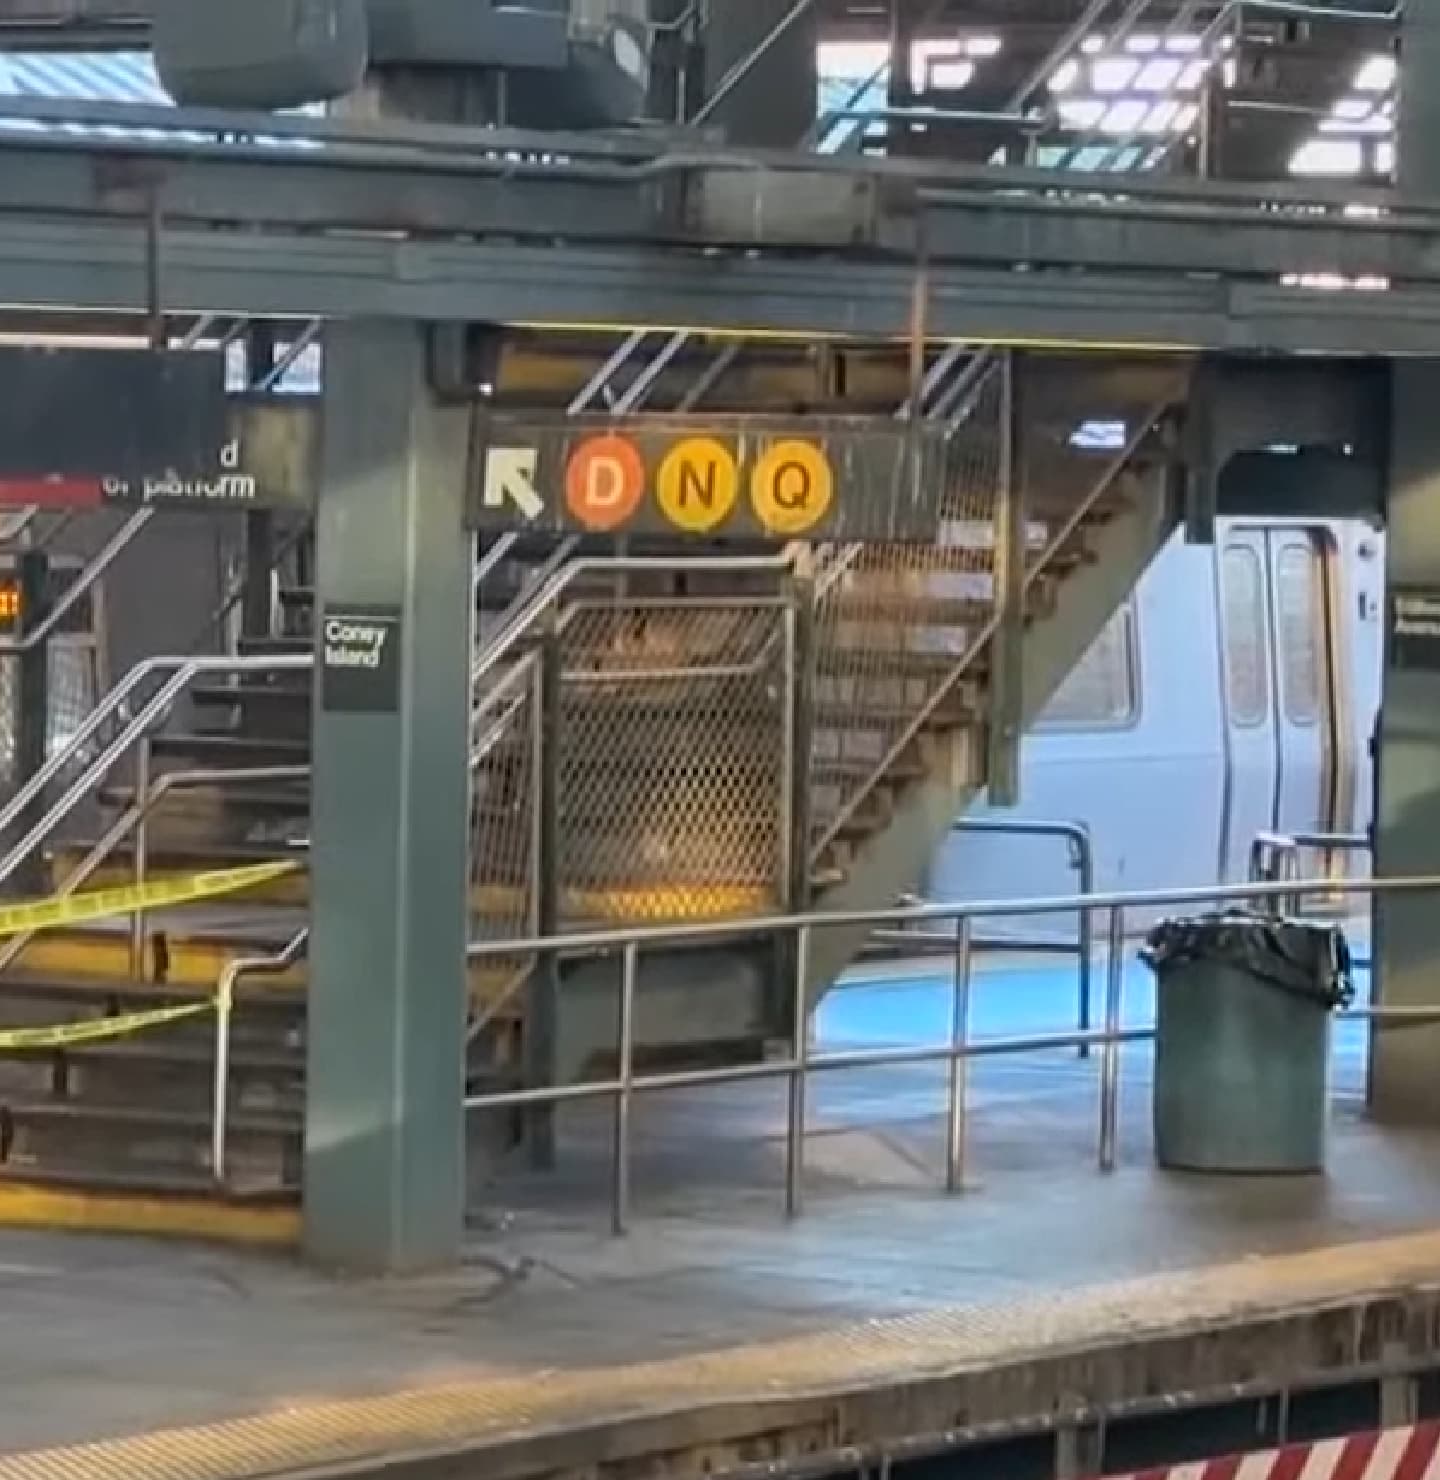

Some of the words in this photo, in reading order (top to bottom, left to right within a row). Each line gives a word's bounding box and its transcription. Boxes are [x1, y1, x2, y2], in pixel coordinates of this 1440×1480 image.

[586, 456, 624, 506] D
[678, 460, 716, 508] N
[773, 461, 810, 509] Q
[326, 622, 386, 648] Coney
[325, 645, 380, 667] Island
